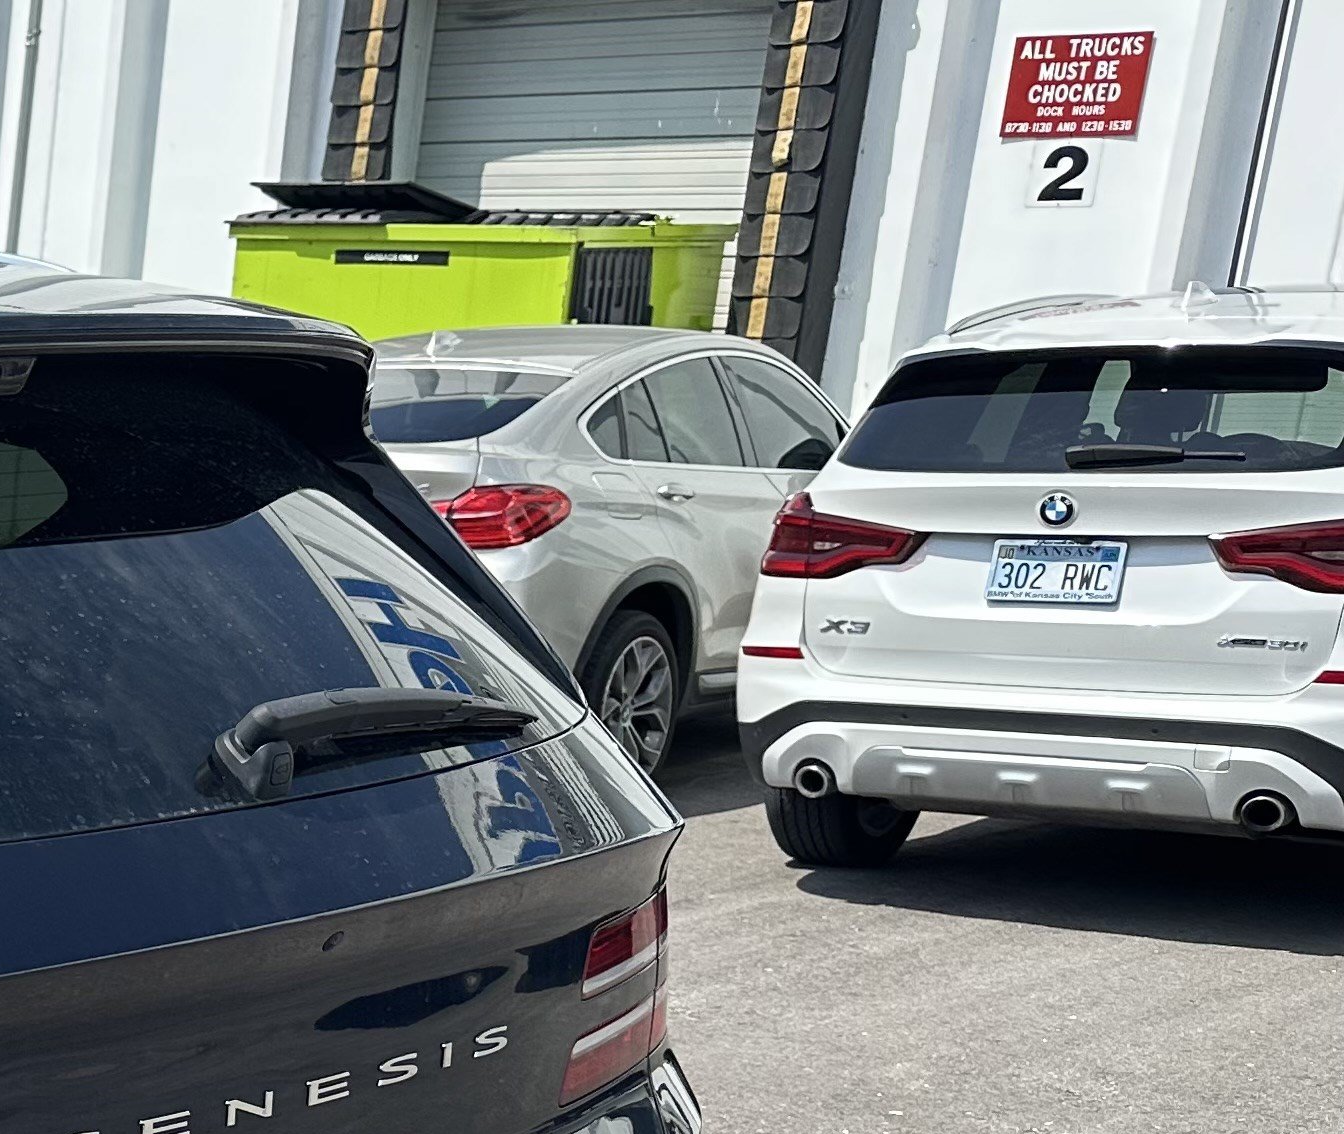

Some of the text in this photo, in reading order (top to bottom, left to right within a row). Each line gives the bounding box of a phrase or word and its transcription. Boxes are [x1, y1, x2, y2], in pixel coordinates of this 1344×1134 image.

[1020, 36, 1145, 59] ALL TRUCKS
[1038, 60, 1120, 81] MUST BE
[1028, 83, 1121, 103] CHOCKED
[1036, 105, 1106, 117] DOCK HOURS
[1056, 121, 1077, 132] AND
[1037, 145, 1089, 201] 2
[1026, 546, 1095, 557] KANSAS
[998, 562, 1113, 591] 302 RWC
[1024, 591, 1060, 599] Kansas
[1062, 592, 1083, 600] City
[819, 618, 870, 635] X3
